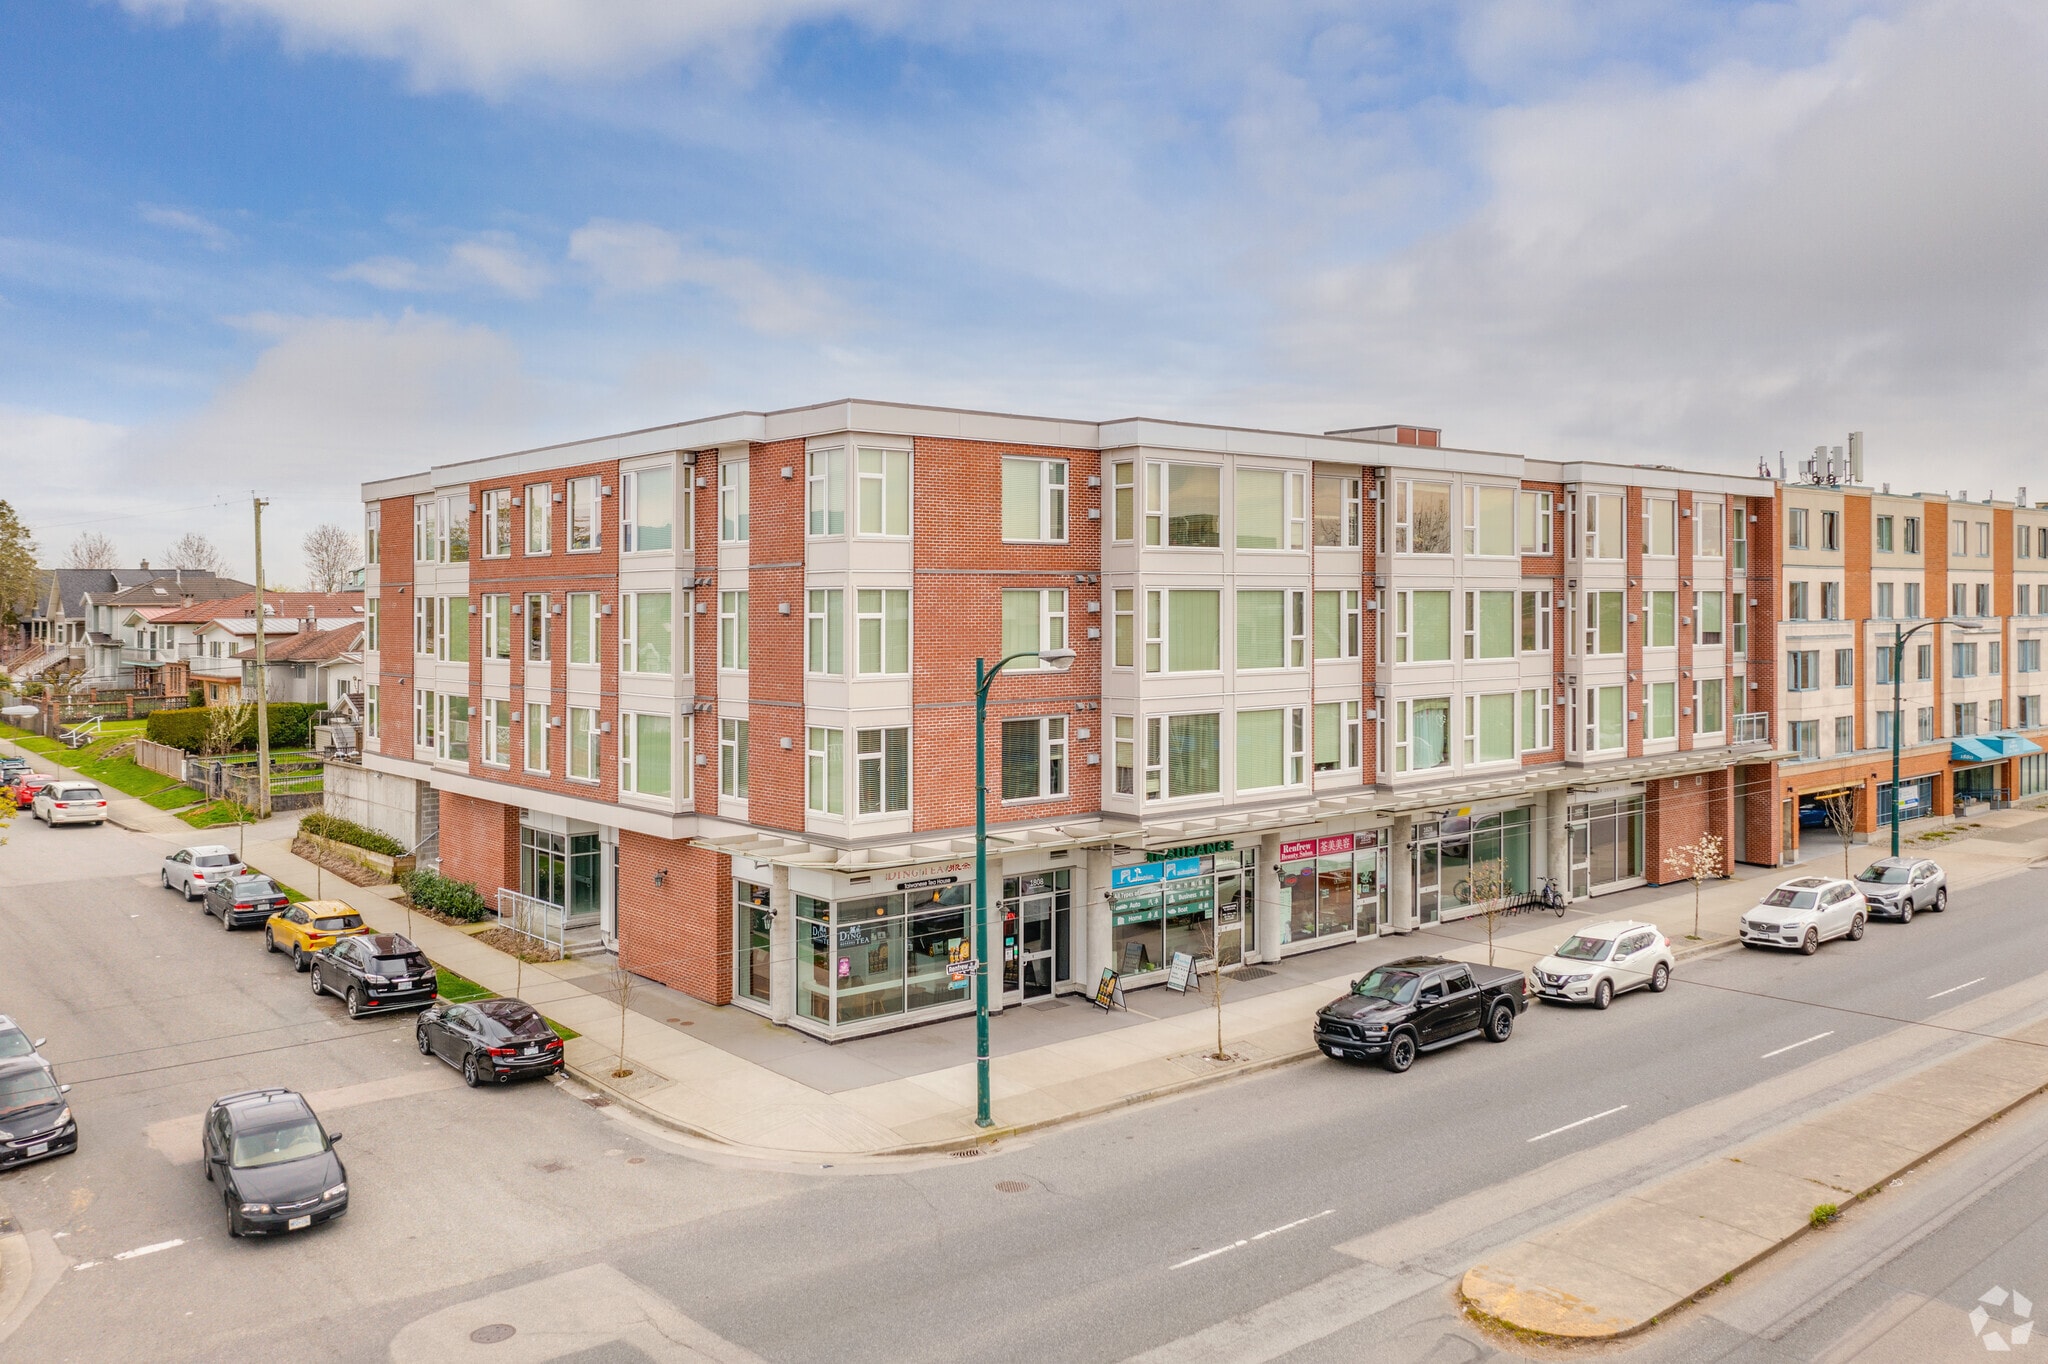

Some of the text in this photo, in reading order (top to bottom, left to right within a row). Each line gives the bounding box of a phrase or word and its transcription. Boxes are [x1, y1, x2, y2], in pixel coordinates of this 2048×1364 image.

[1146, 841, 1234, 862] INSURANCE
[1283, 842, 1311, 854] Renfrew
[904, 881, 927, 889] Taiwanese
[856, 937, 870, 945] TEA
